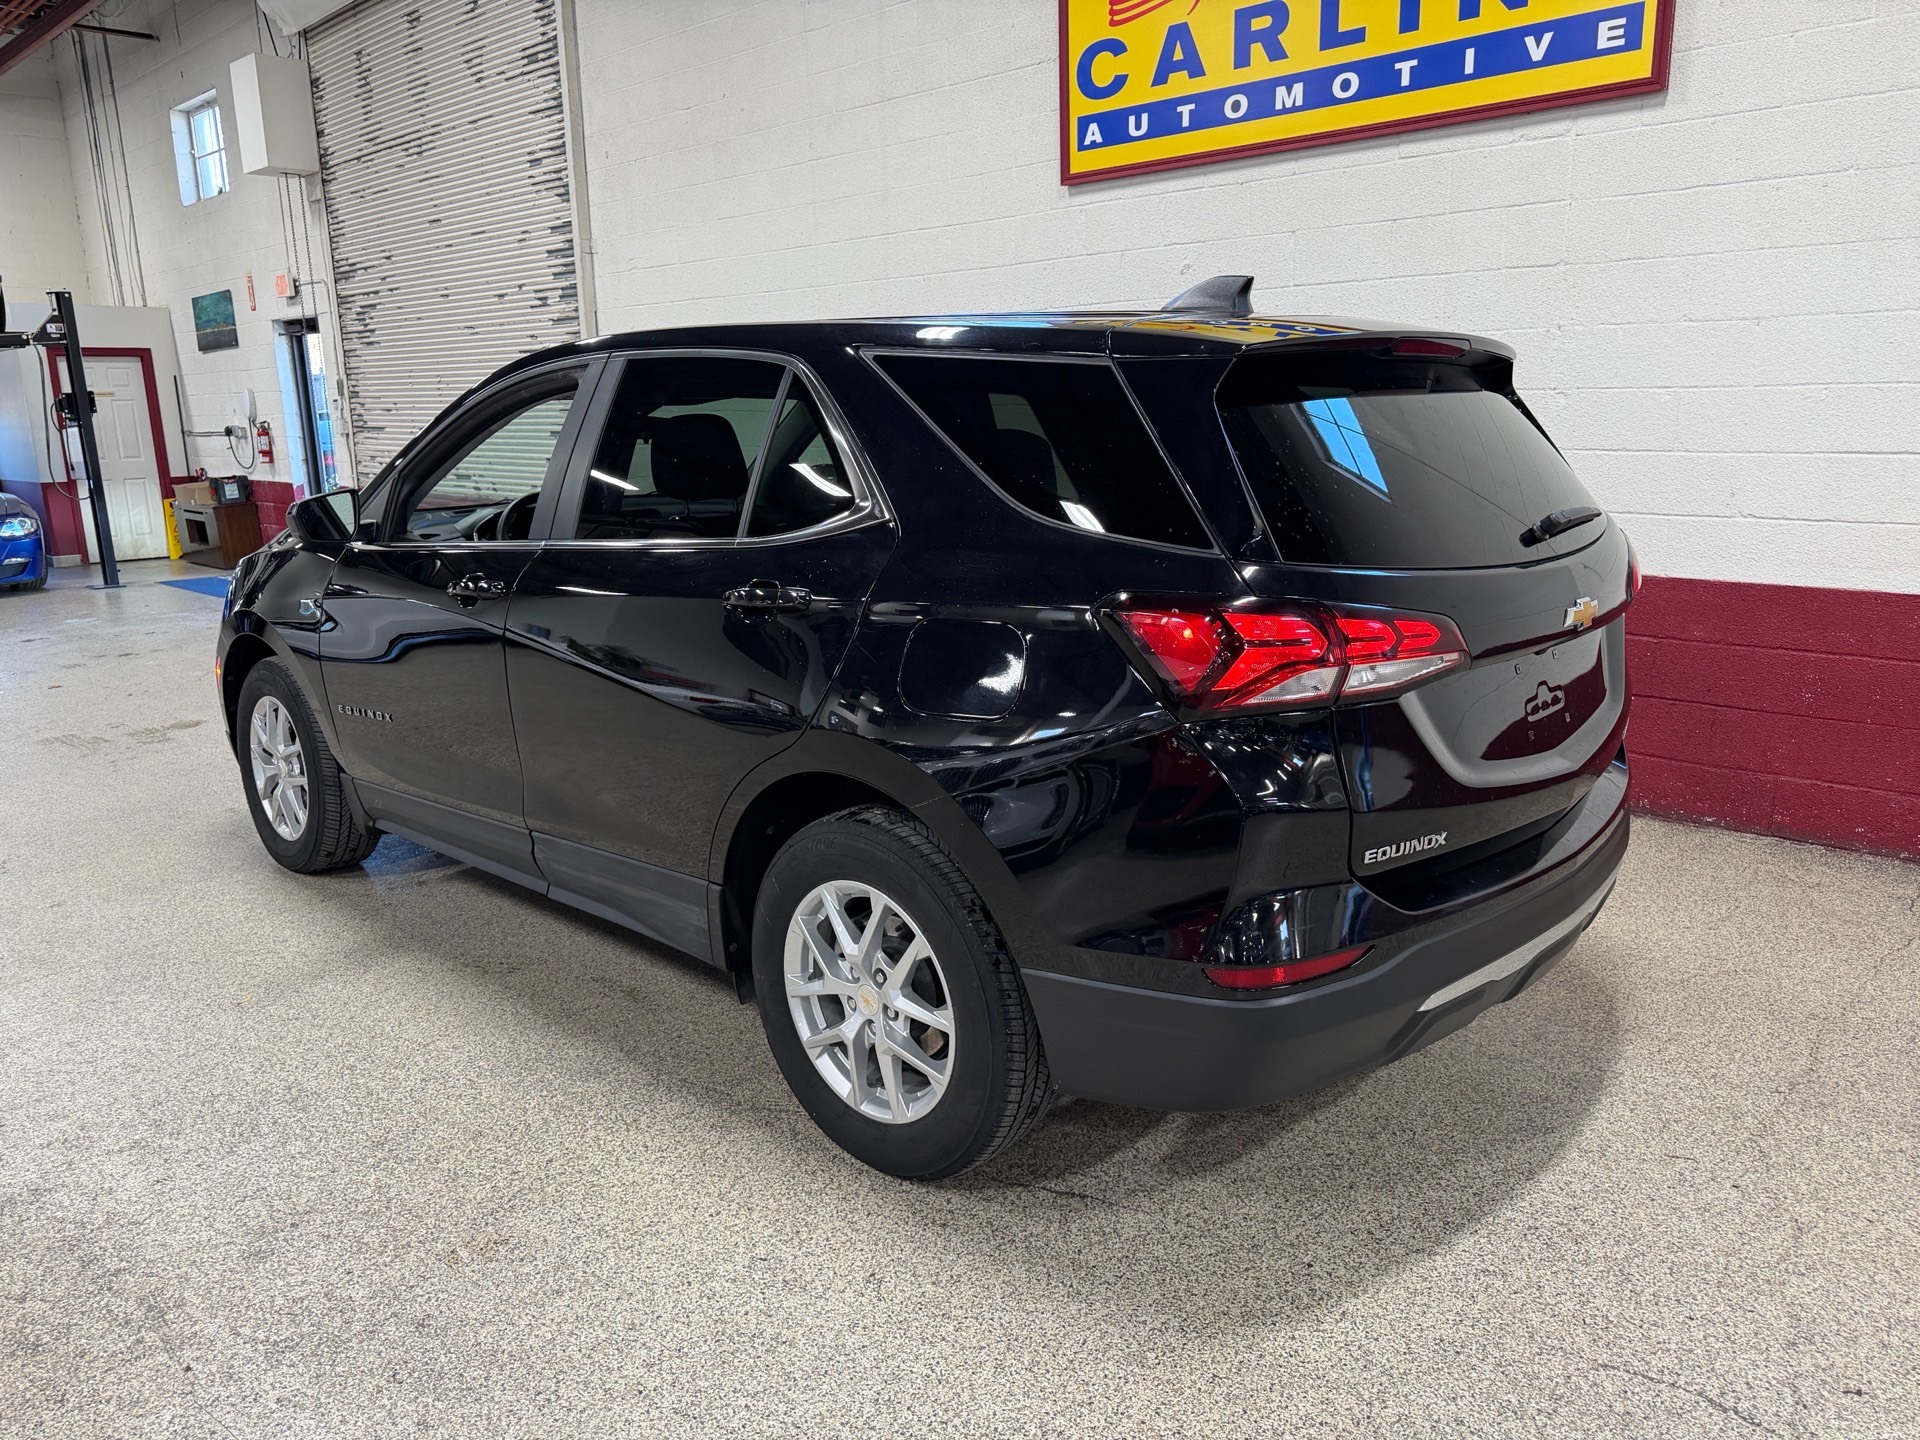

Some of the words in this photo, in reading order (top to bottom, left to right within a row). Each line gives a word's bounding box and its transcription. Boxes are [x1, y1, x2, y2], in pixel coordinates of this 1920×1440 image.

[1083, 17, 1627, 146] AUTOMOTIVE
[338, 704, 392, 723] EQUINOX
[1363, 830, 1448, 864] EQUINOX
